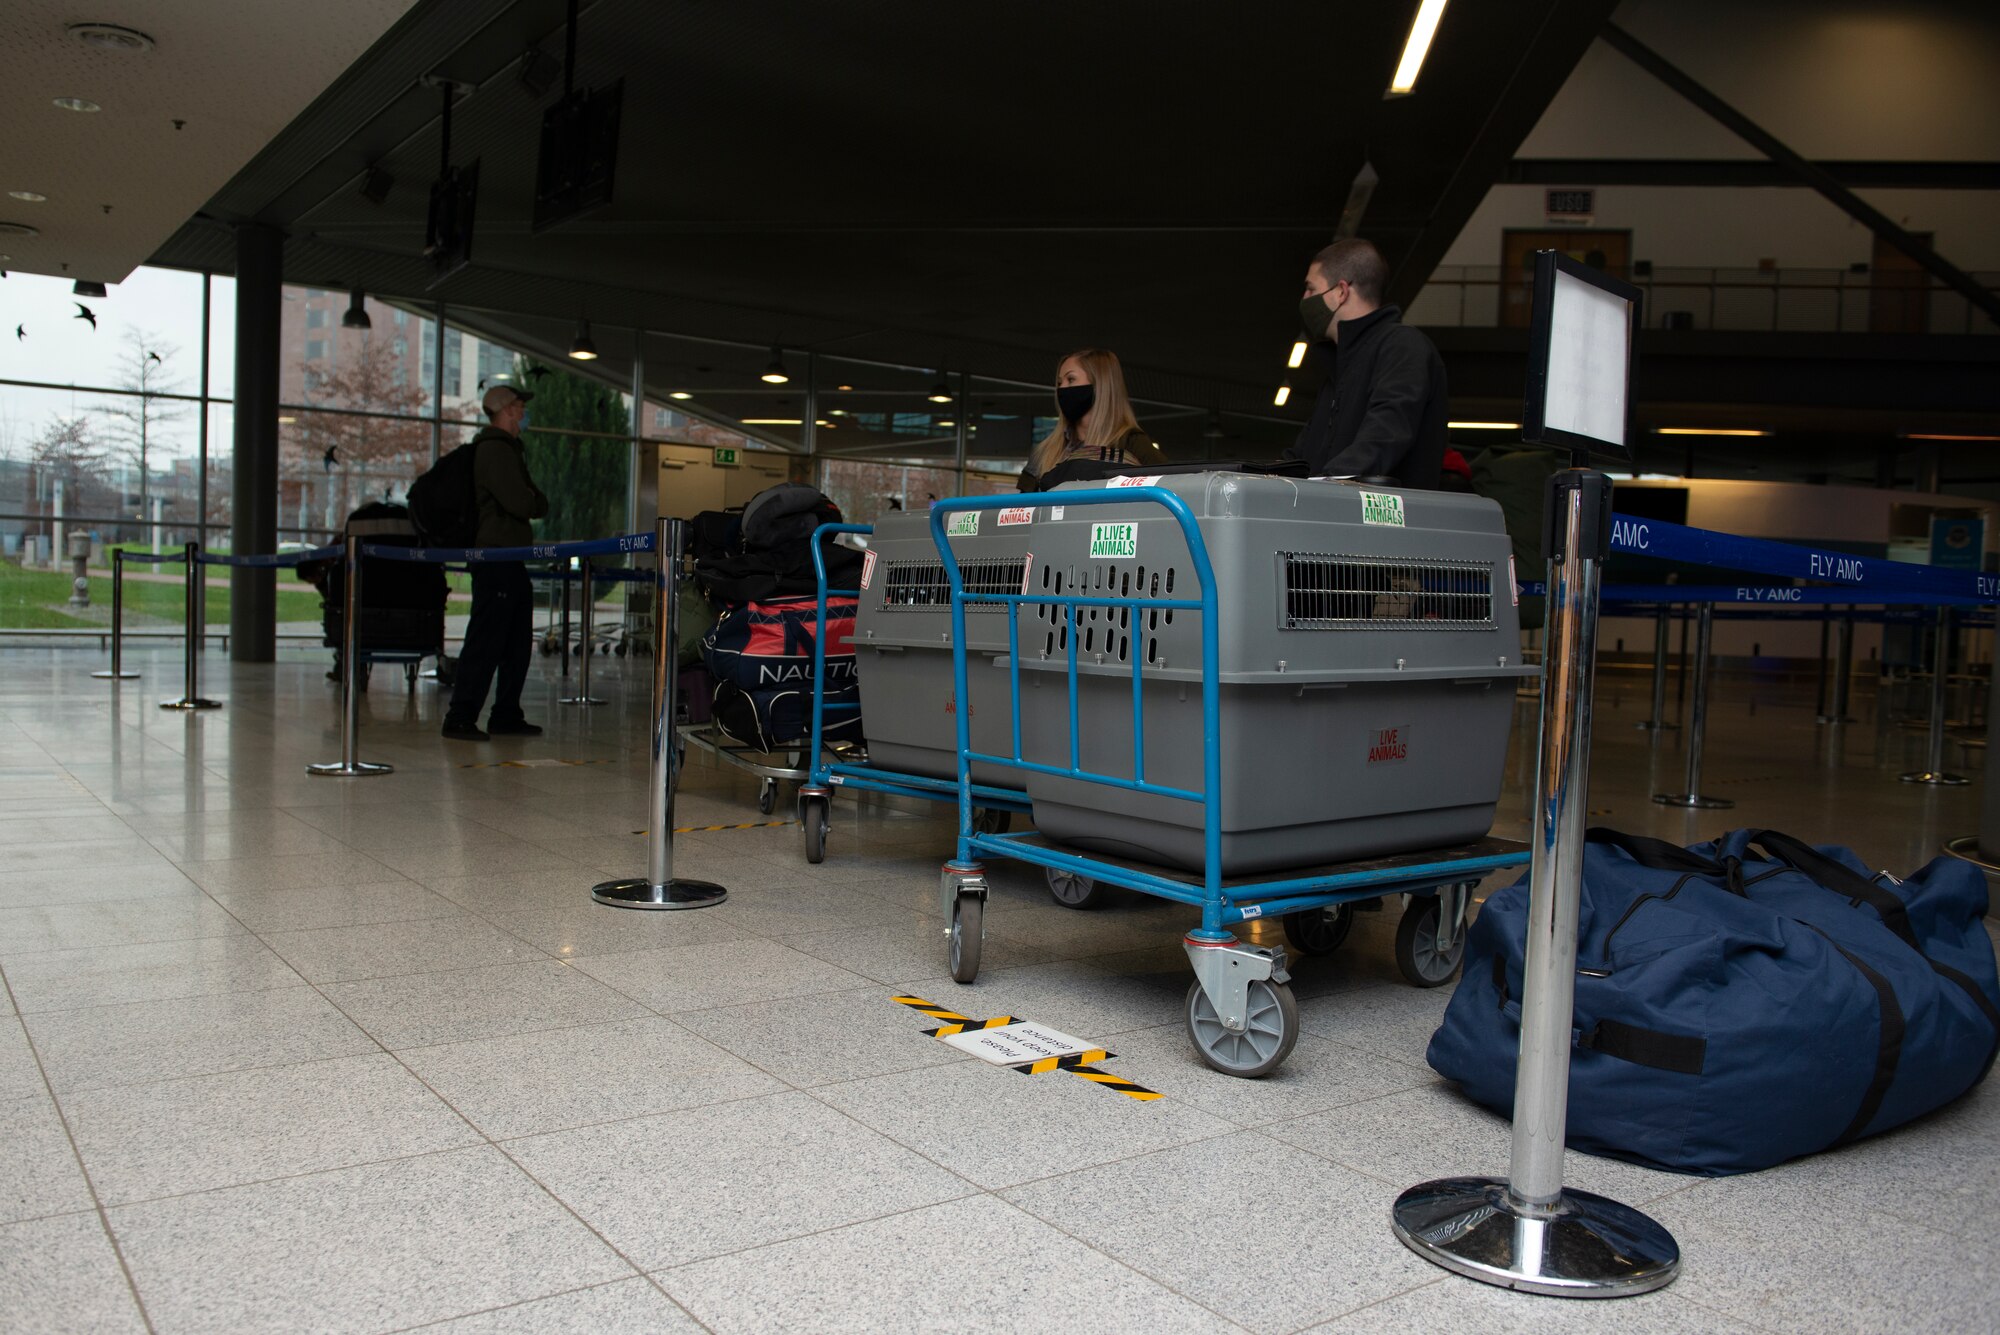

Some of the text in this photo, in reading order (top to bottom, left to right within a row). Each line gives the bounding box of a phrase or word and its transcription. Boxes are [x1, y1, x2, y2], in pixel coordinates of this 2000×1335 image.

[1120, 477, 1147, 486] LIVE
[1372, 494, 1392, 509] LIVE
[1000, 512, 1031, 524] ANIMALS
[1365, 507, 1403, 525] ANIMALS
[1104, 526, 1124, 540] LIVE
[1611, 520, 1649, 549] AMC
[620, 535, 648, 551] FLY AMC
[1092, 540, 1135, 555] ANIMALS
[1811, 554, 1863, 581] FLY AMC
[1978, 576, 1995, 596] FLY
[1737, 588, 1802, 601] FLY AMC
[1380, 729, 1397, 745] LIVE
[1368, 744, 1406, 762] ANIMALS
[1022, 1029, 1073, 1050] distance
